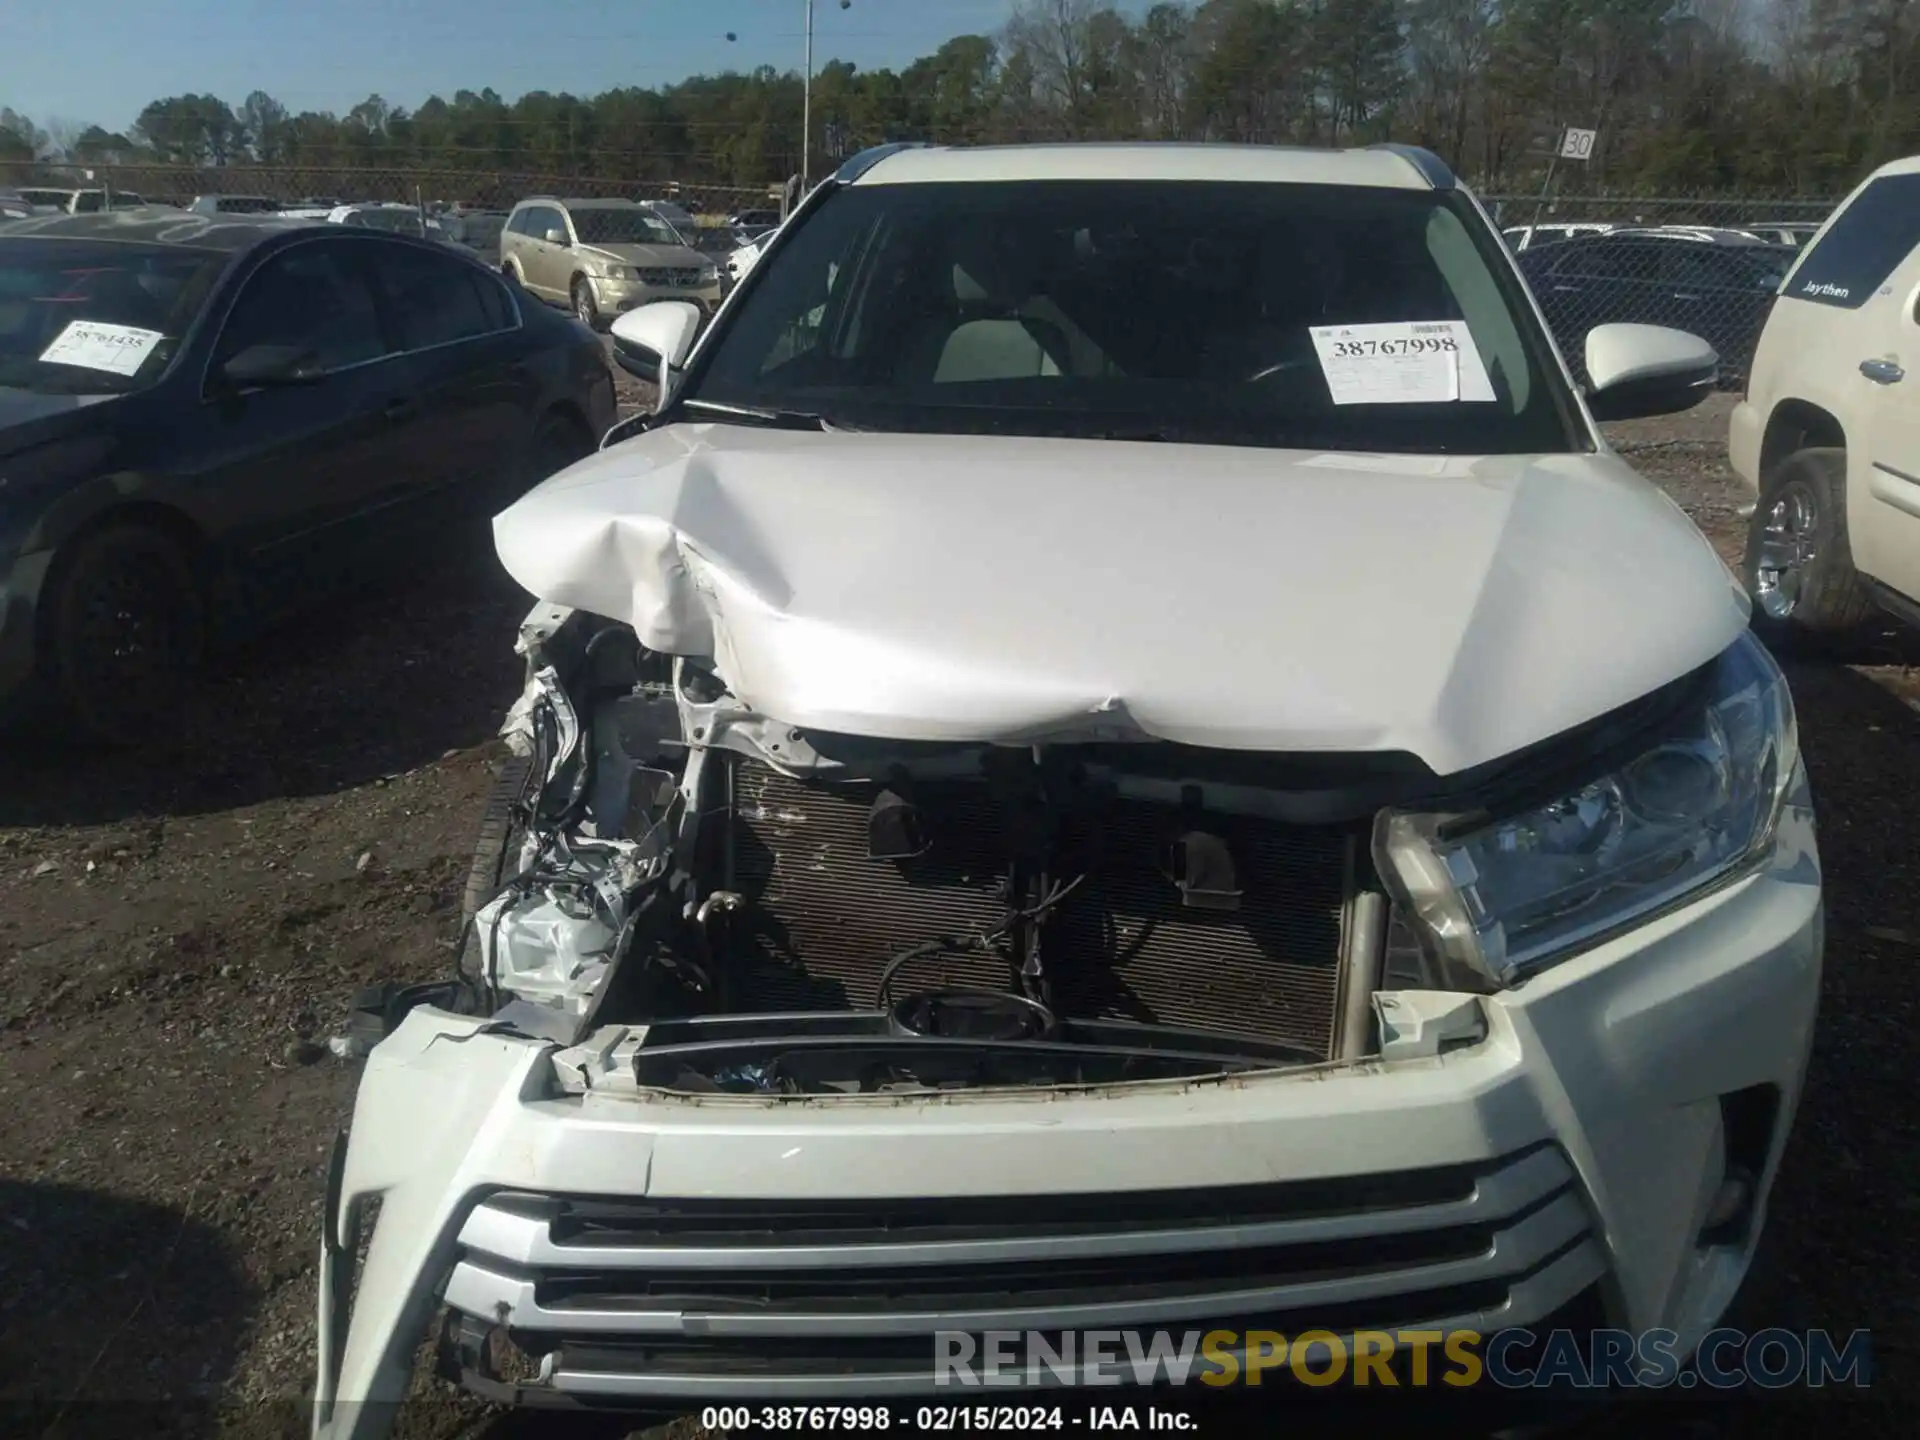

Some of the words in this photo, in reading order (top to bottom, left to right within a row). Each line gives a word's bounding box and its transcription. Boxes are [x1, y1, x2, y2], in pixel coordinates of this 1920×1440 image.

[1565, 132, 1591, 155] 30
[1802, 280, 1850, 299] Jaythen
[1333, 336, 1460, 358] 38767998
